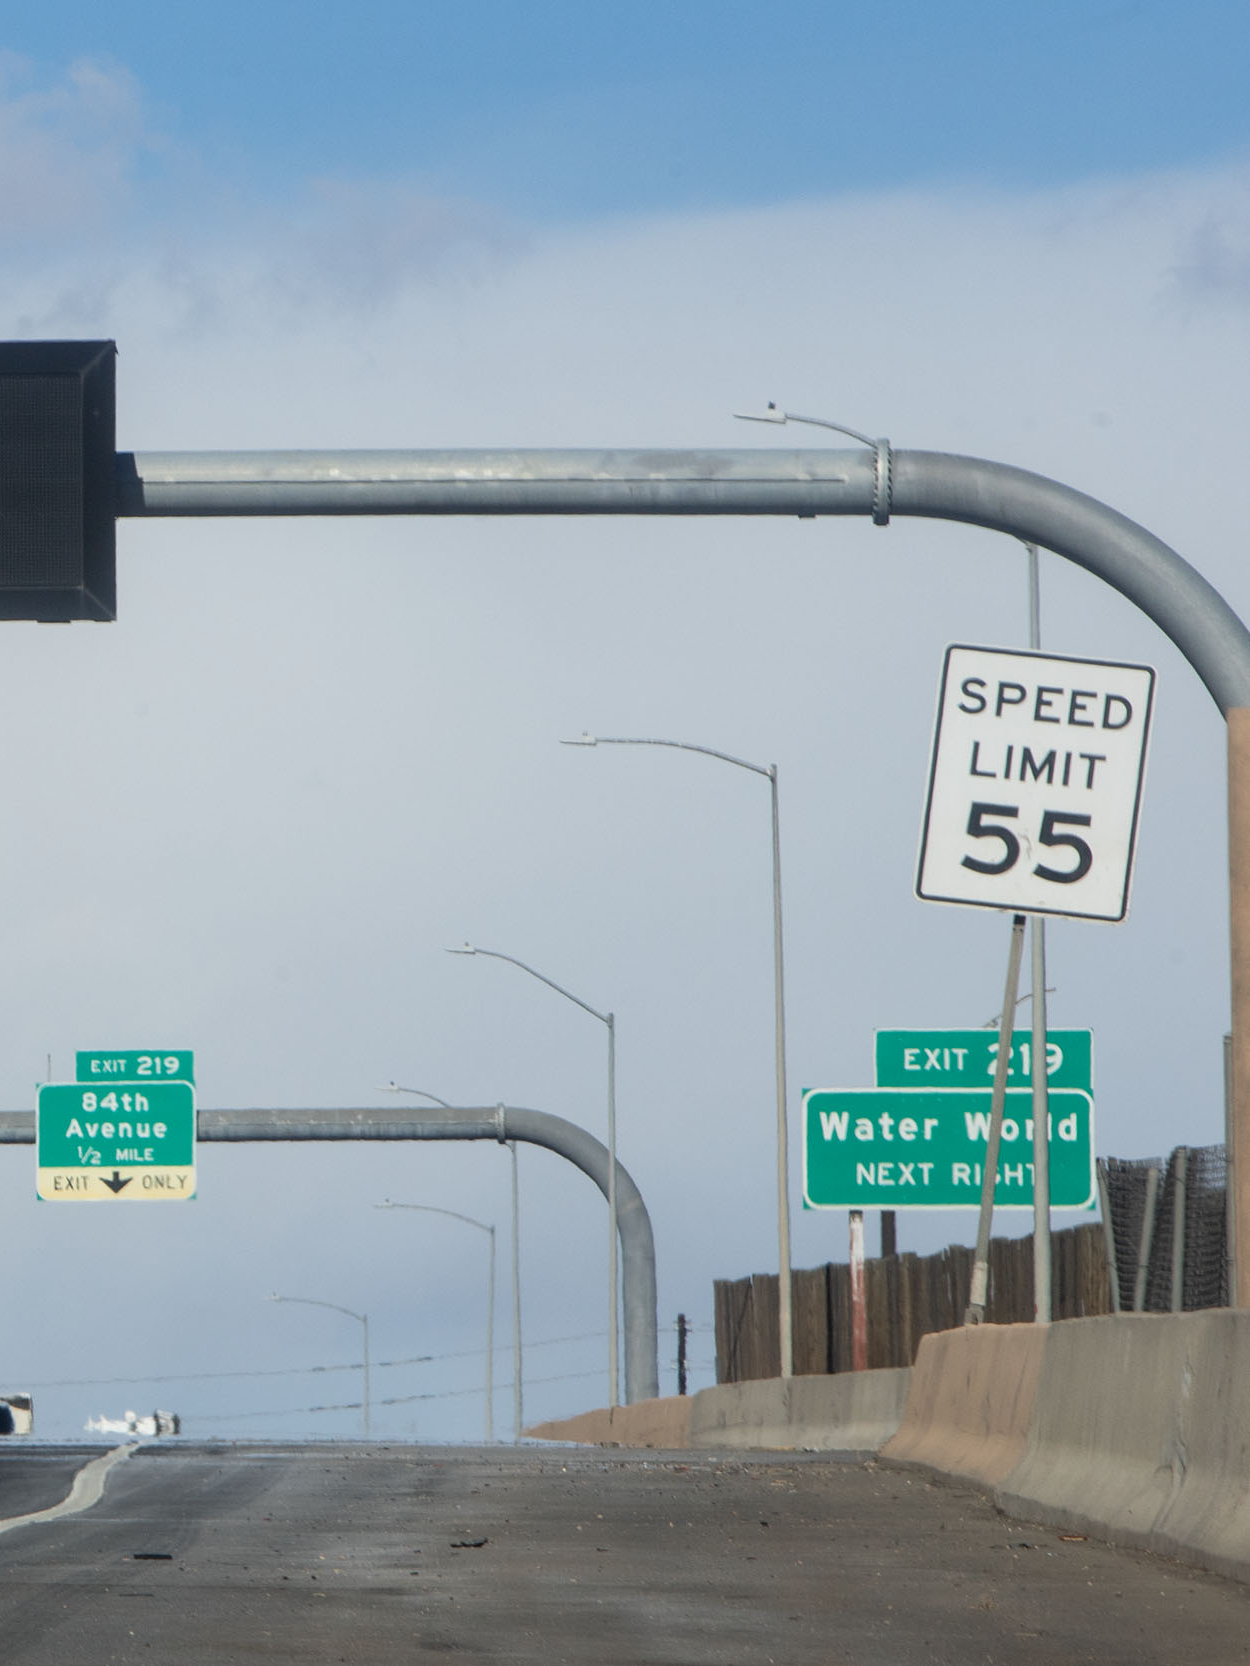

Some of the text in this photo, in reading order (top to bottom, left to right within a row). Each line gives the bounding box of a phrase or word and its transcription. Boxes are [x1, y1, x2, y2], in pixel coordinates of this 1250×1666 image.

[958, 677, 1133, 730] SPEED
[969, 740, 1107, 790] LIMIT
[960, 801, 1093, 884] 55
[90, 1056, 180, 1075] EXIT 219
[903, 1042, 1064, 1076] EXIT 219
[82, 1092, 149, 1112] 84th
[65, 1118, 168, 1139] Avenue
[819, 1111, 939, 1142] Water
[116, 1148, 155, 1162] MILE
[54, 1174, 188, 1191] EXIT ONLY
[856, 1162, 1035, 1187] NEXT RIHT
